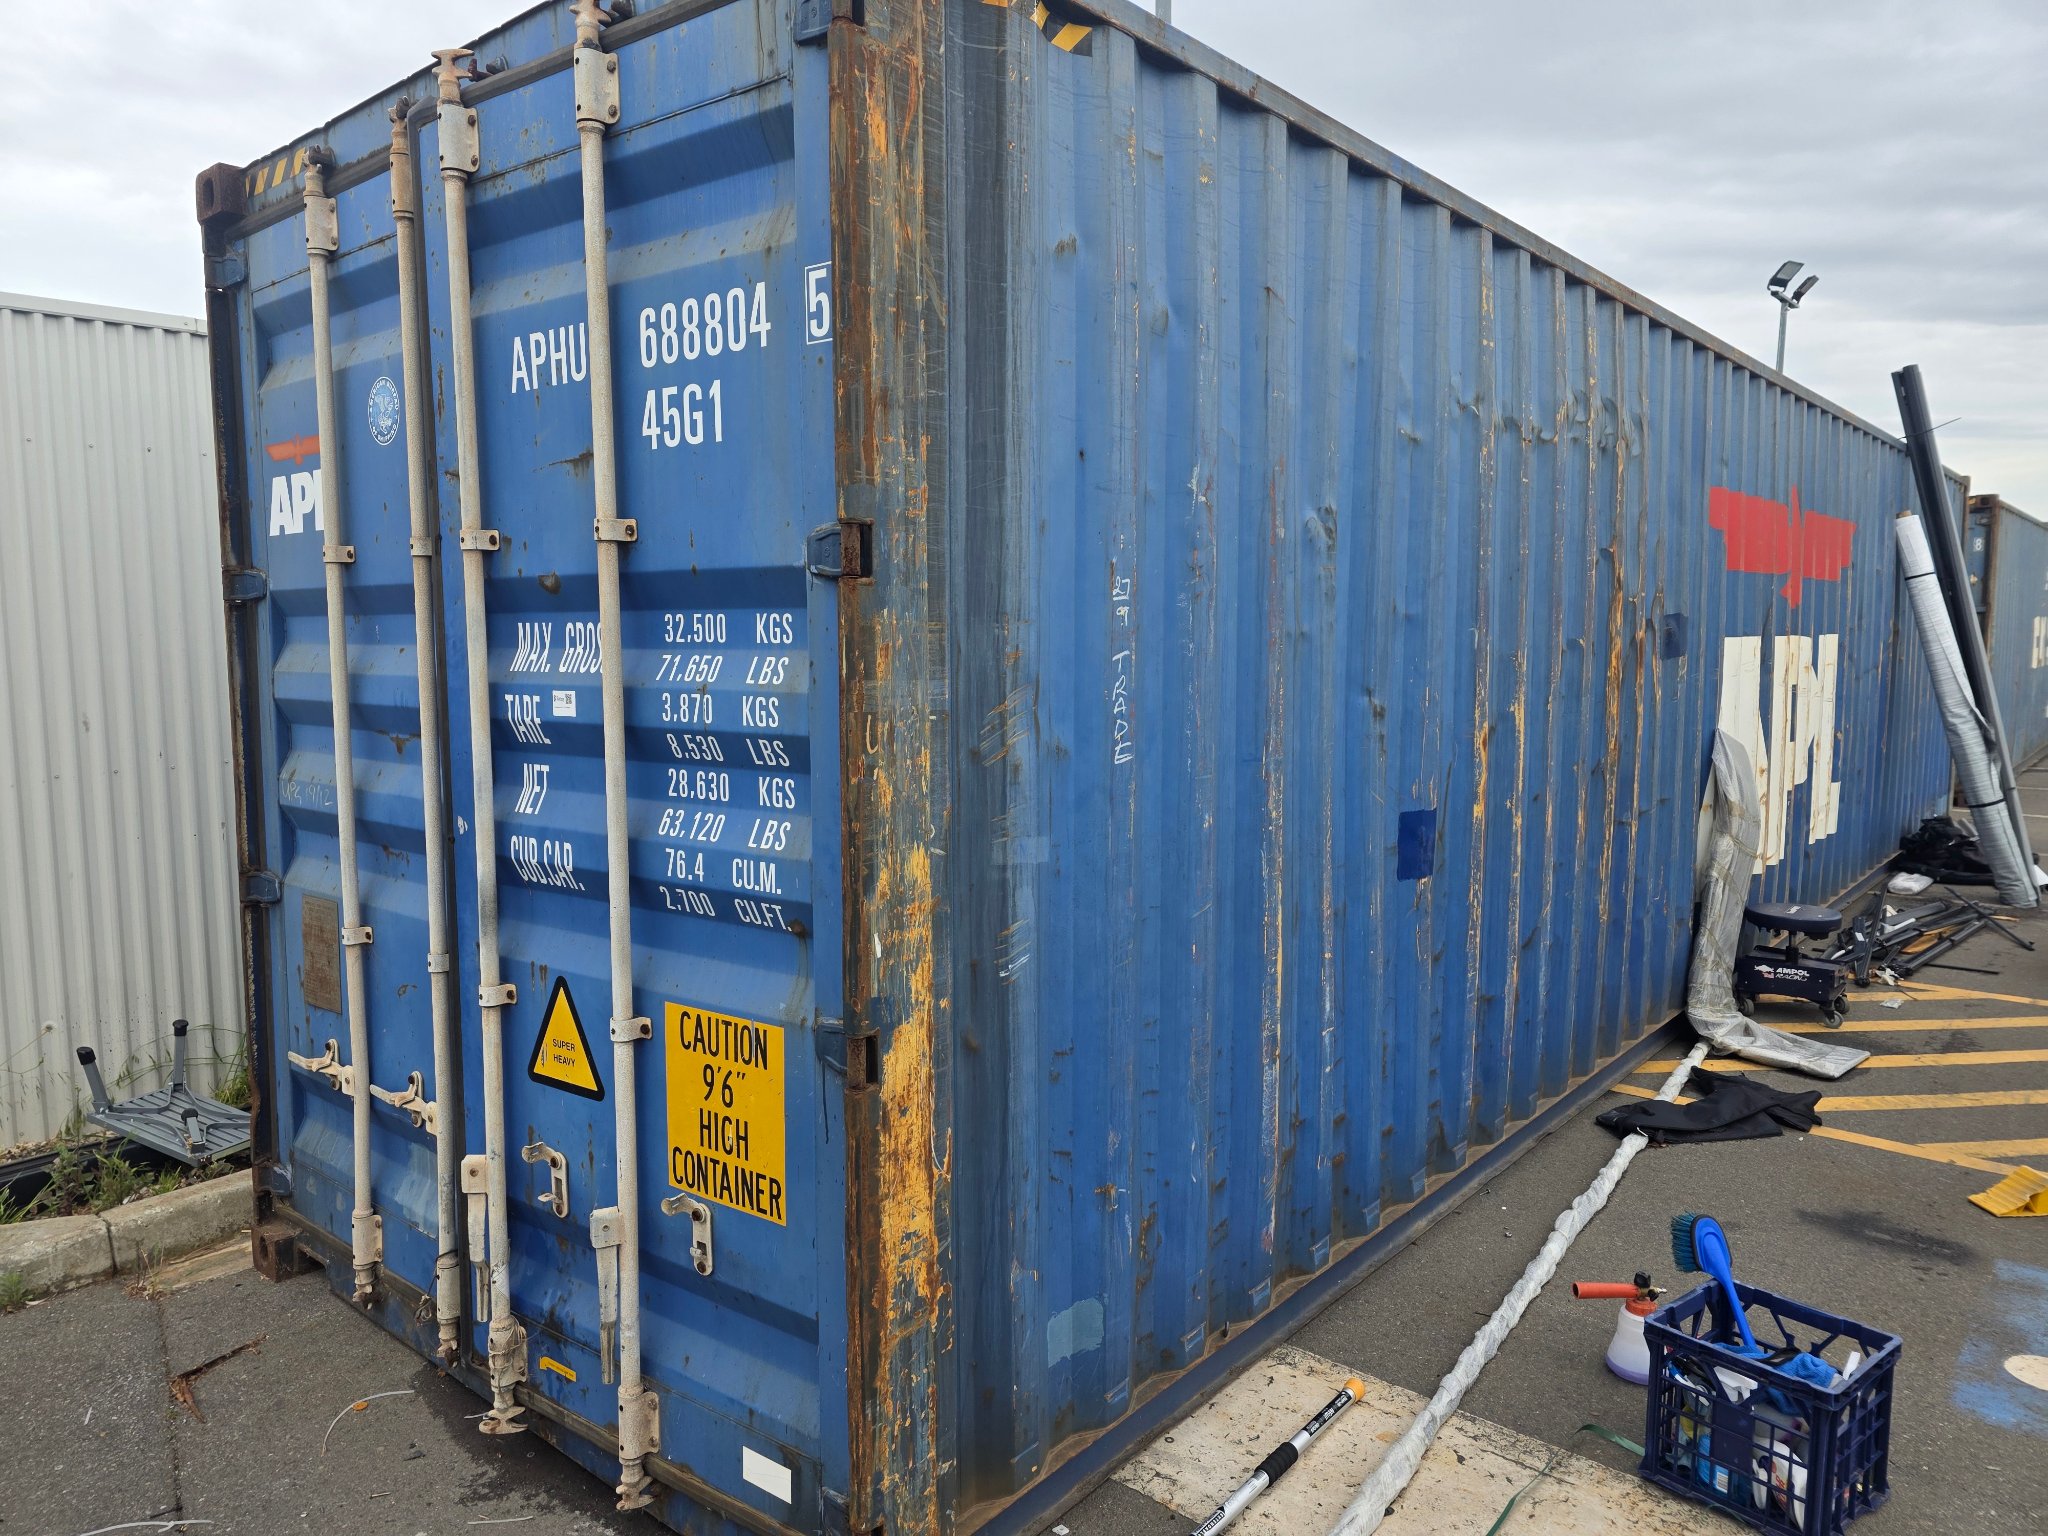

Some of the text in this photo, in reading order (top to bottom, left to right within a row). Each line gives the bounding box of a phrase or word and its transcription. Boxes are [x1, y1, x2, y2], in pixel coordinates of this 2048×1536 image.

[511, 268, 831, 393] APHU 688804 5
[641, 379, 723, 450] 45G1
[509, 613, 794, 674] MAX. GROS 32,500 KGS
[655, 654, 789, 685] 71,650 LBS
[504, 692, 780, 745] TARE 3,870 KGS
[1112, 650, 1134, 765] TRADE
[666, 733, 790, 767] 8,530 LBS
[514, 762, 796, 815] NET 28,630 KGS
[658, 807, 791, 851] 63,120 LBS
[665, 847, 705, 882] 76.4
[732, 857, 782, 895] CU.M.
[1775, 967, 1810, 977] AMPOL
[552, 1038, 576, 1052] SUPER
[553, 1053, 576, 1067] HEAVY
[680, 1010, 768, 1070] CAUTION
[699, 1107, 749, 1161] HIGH
[672, 1146, 783, 1220] CONTAINER
